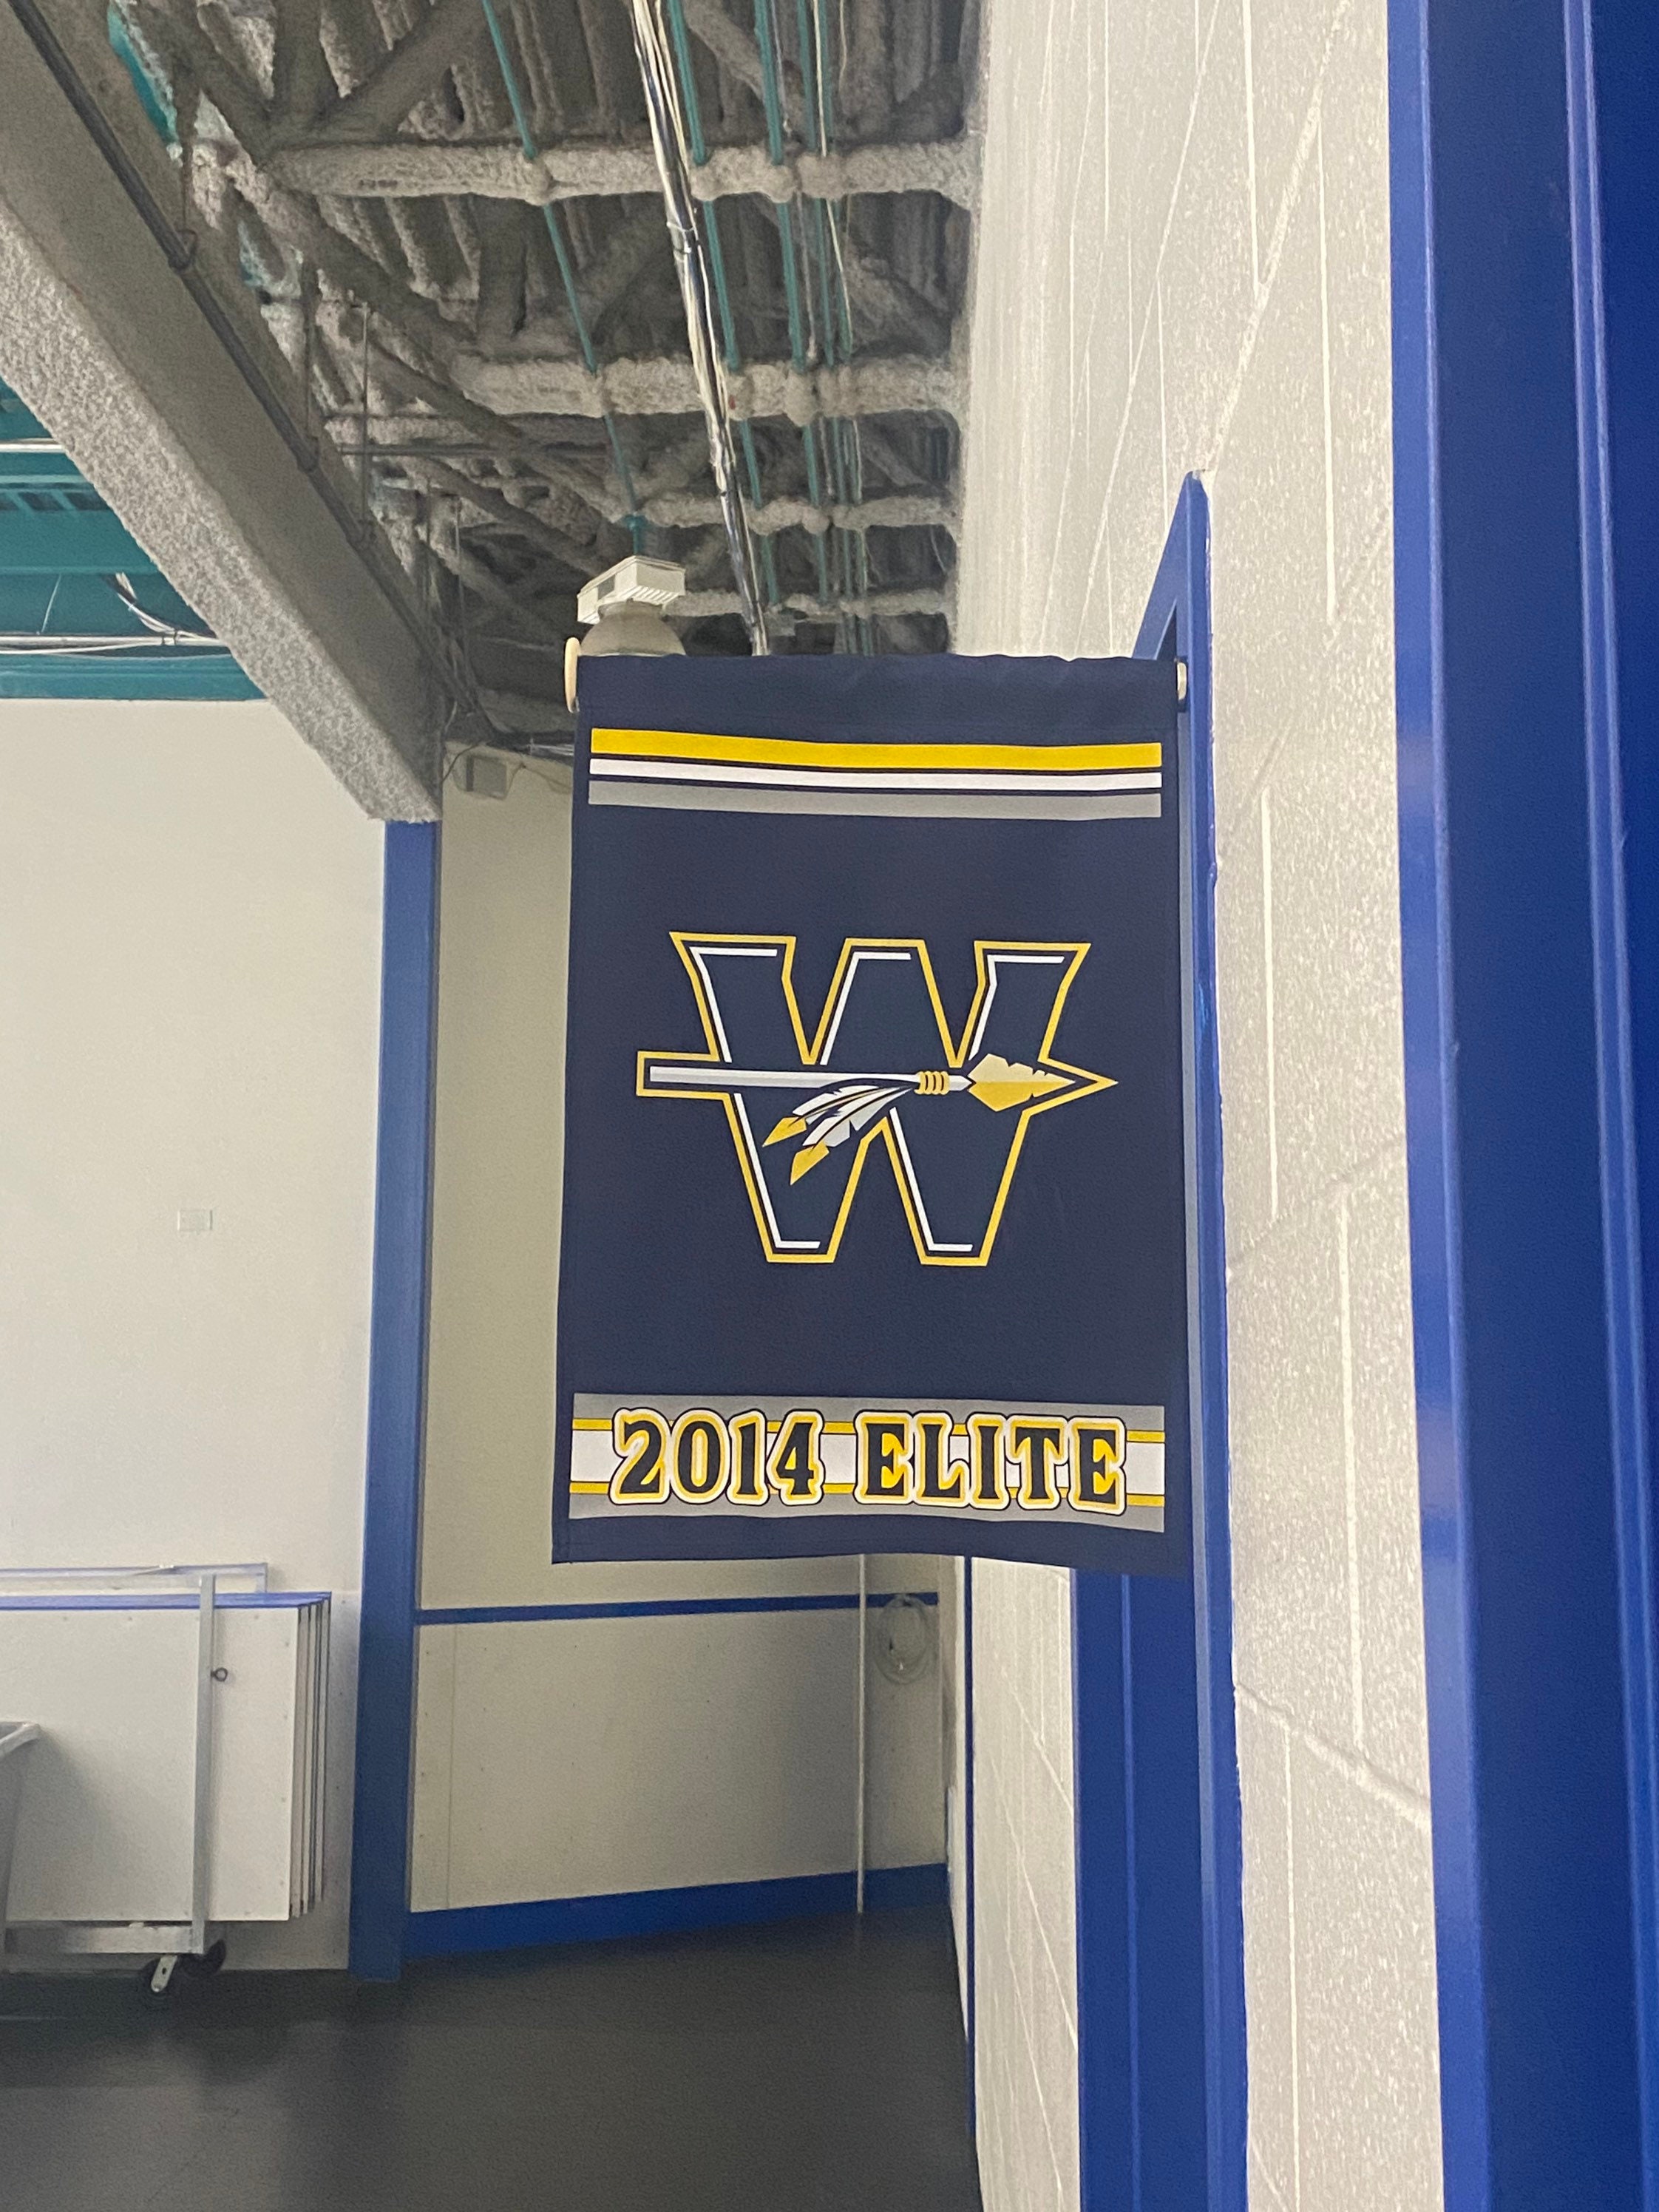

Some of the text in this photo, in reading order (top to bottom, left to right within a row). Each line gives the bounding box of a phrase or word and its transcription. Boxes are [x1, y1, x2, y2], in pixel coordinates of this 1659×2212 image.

[668, 931, 1093, 1267] W
[610, 1408, 1126, 1515] 2014 ELITE
